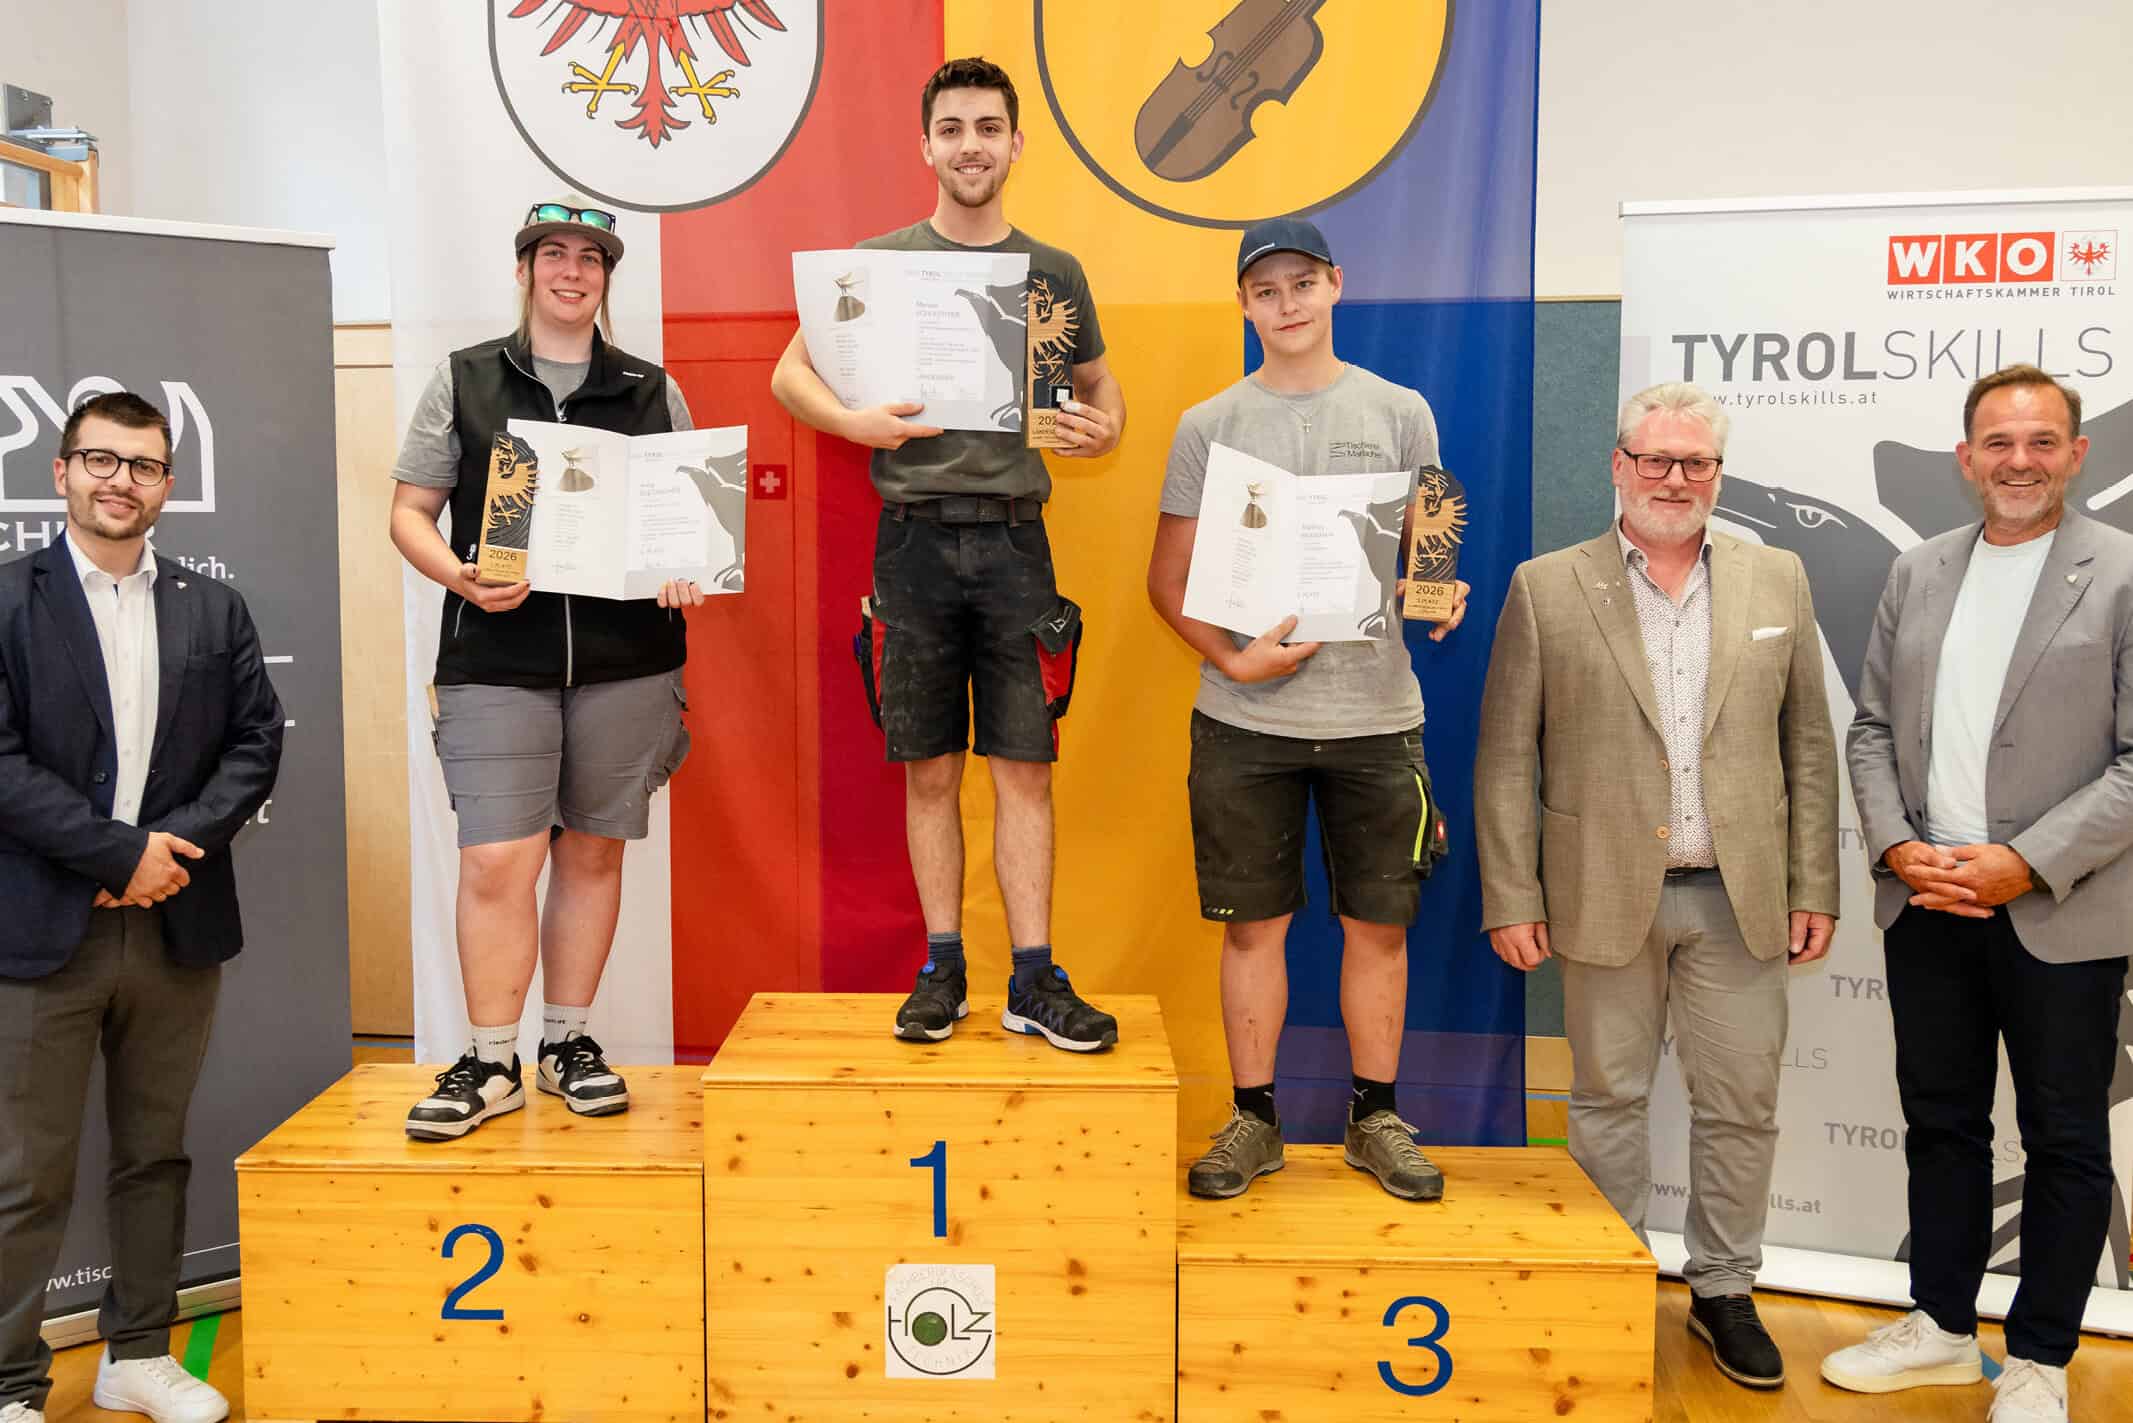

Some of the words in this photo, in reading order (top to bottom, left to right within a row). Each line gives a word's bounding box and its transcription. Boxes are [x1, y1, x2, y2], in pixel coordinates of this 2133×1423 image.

[1891, 237, 2049, 278] WKO
[1887, 286, 2061, 301] WIRTSCHAFTSKAMMER
[2070, 285, 2116, 298] TIROL
[1712, 390, 1878, 409] w.tyrolskills.at
[1037, 415, 1057, 427] 202
[488, 549, 518, 561] 2026
[1415, 584, 1445, 597] 2026
[1830, 974, 1885, 1001] TYR
[1823, 1121, 1906, 1152] TYRO
[910, 1142, 946, 1237] 1
[441, 1224, 504, 1320] 2
[1377, 1296, 1453, 1397] 3
